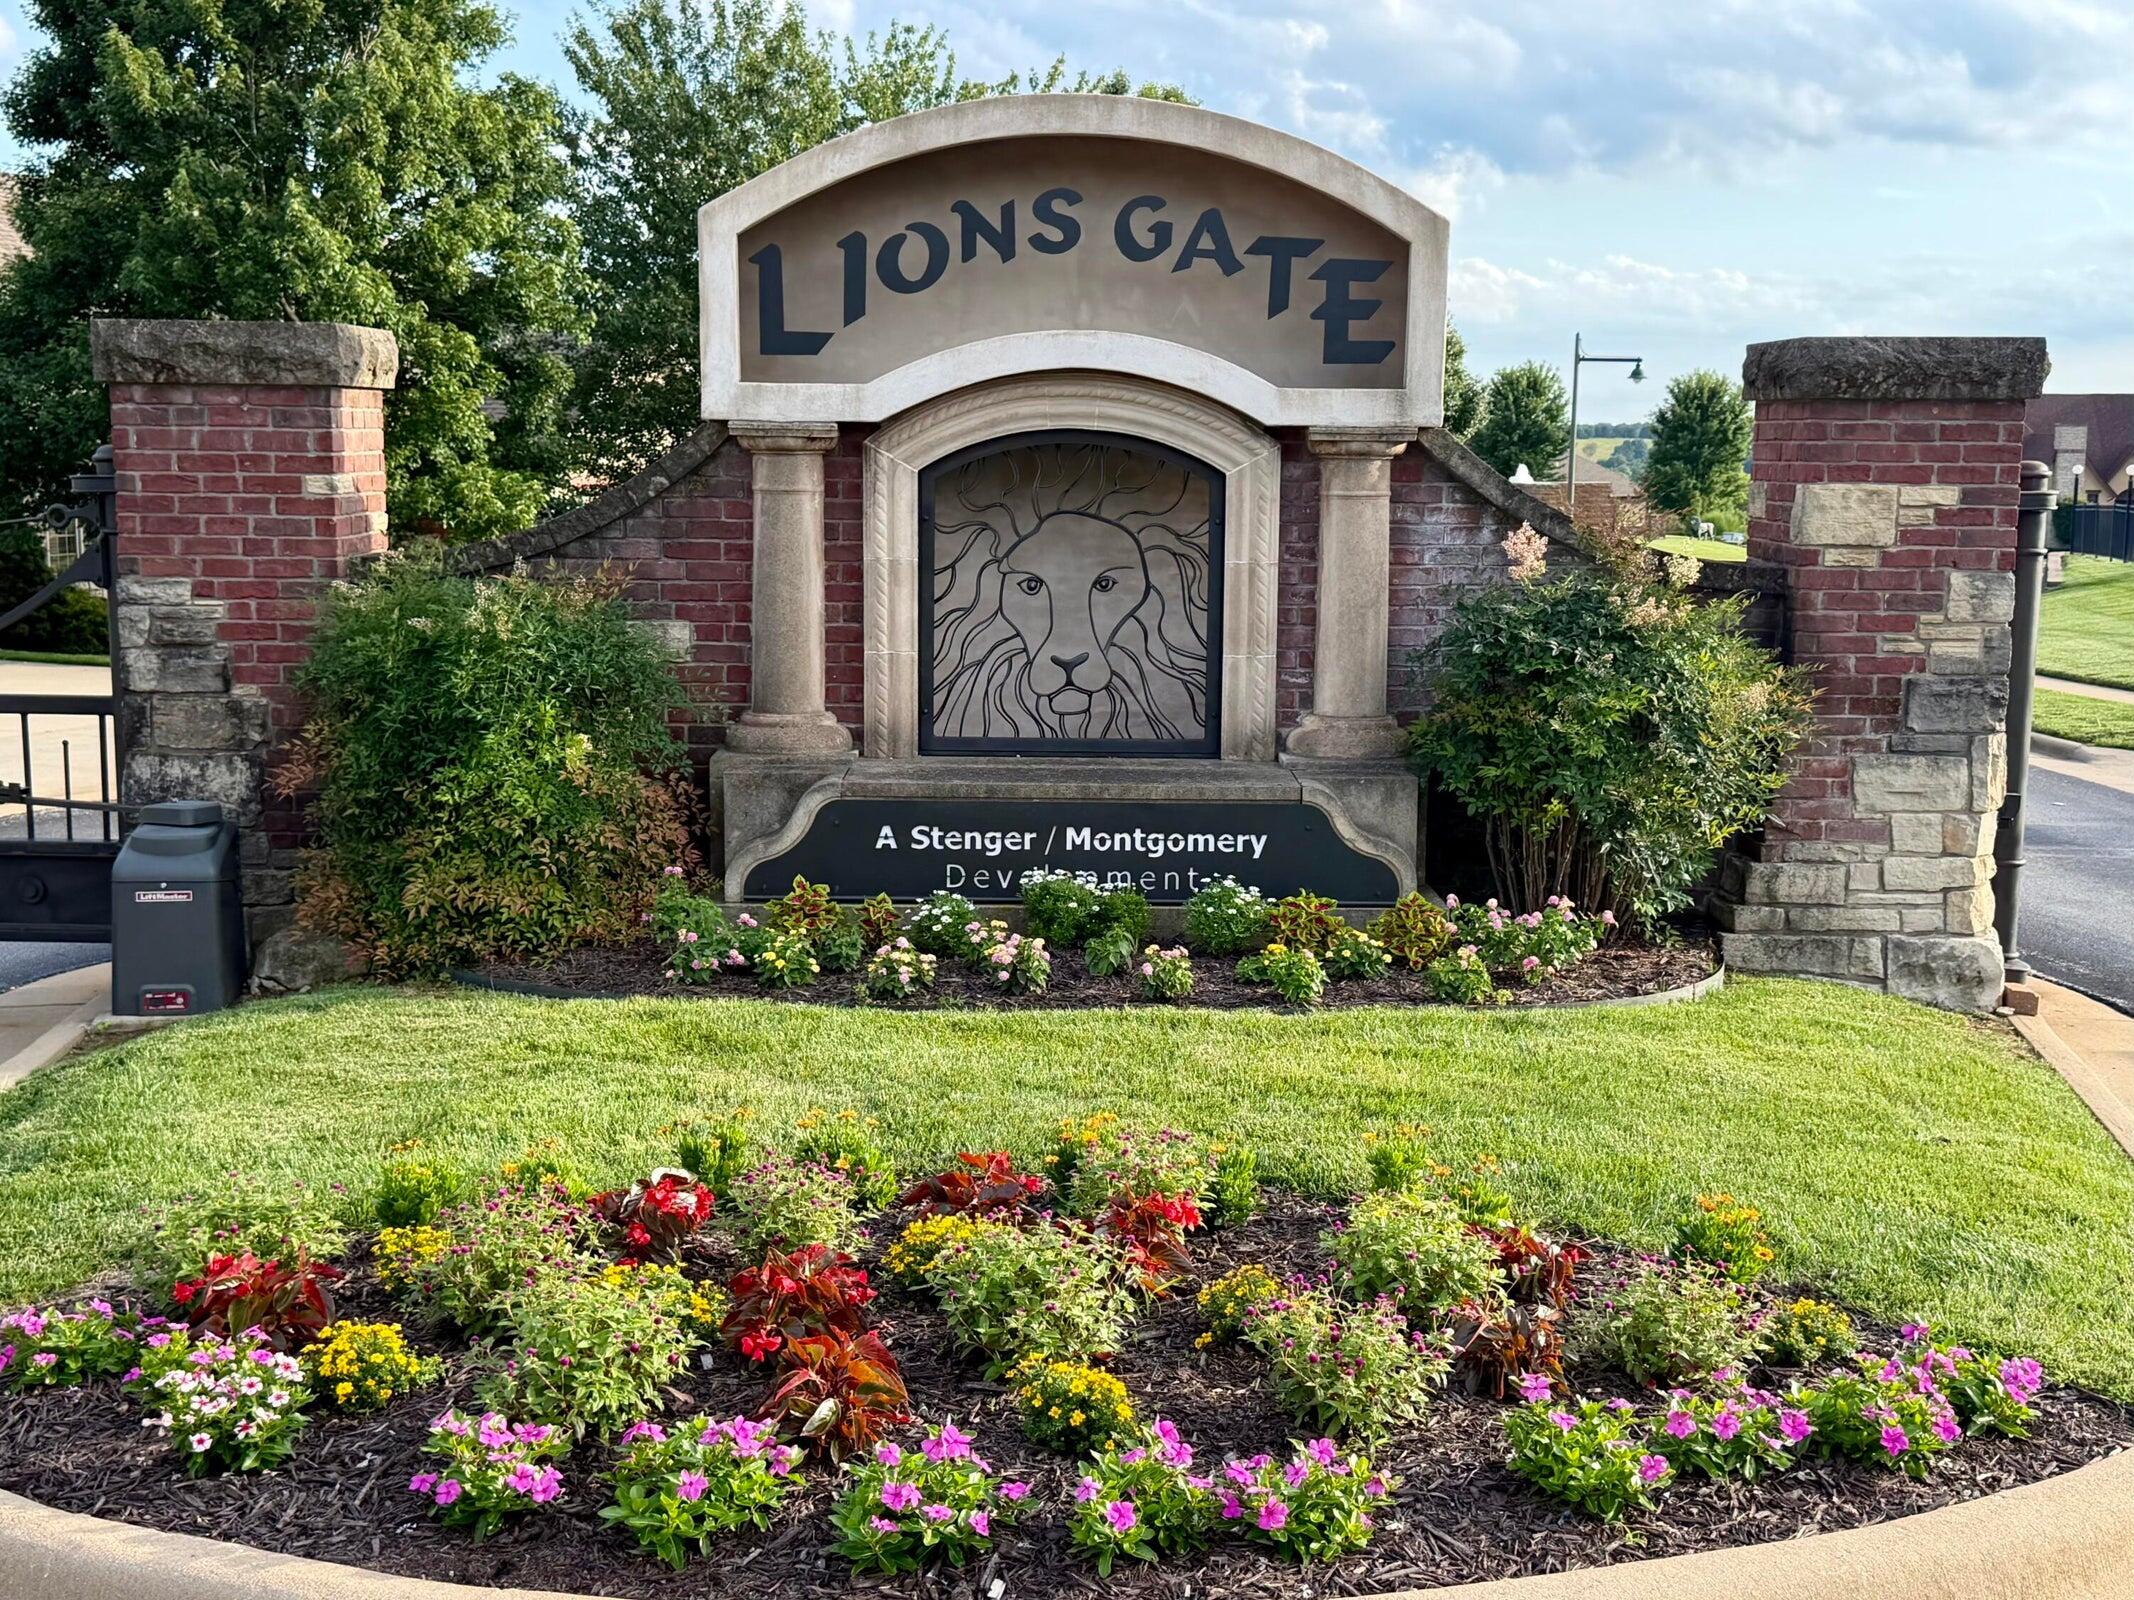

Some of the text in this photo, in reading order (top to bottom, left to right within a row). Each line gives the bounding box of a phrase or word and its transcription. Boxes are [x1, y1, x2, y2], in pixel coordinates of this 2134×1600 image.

[748, 187, 1396, 365] LIONS GATE
[875, 825, 898, 849] A
[911, 825, 1037, 857] Stenger
[1065, 826, 1268, 859] Montgomery
